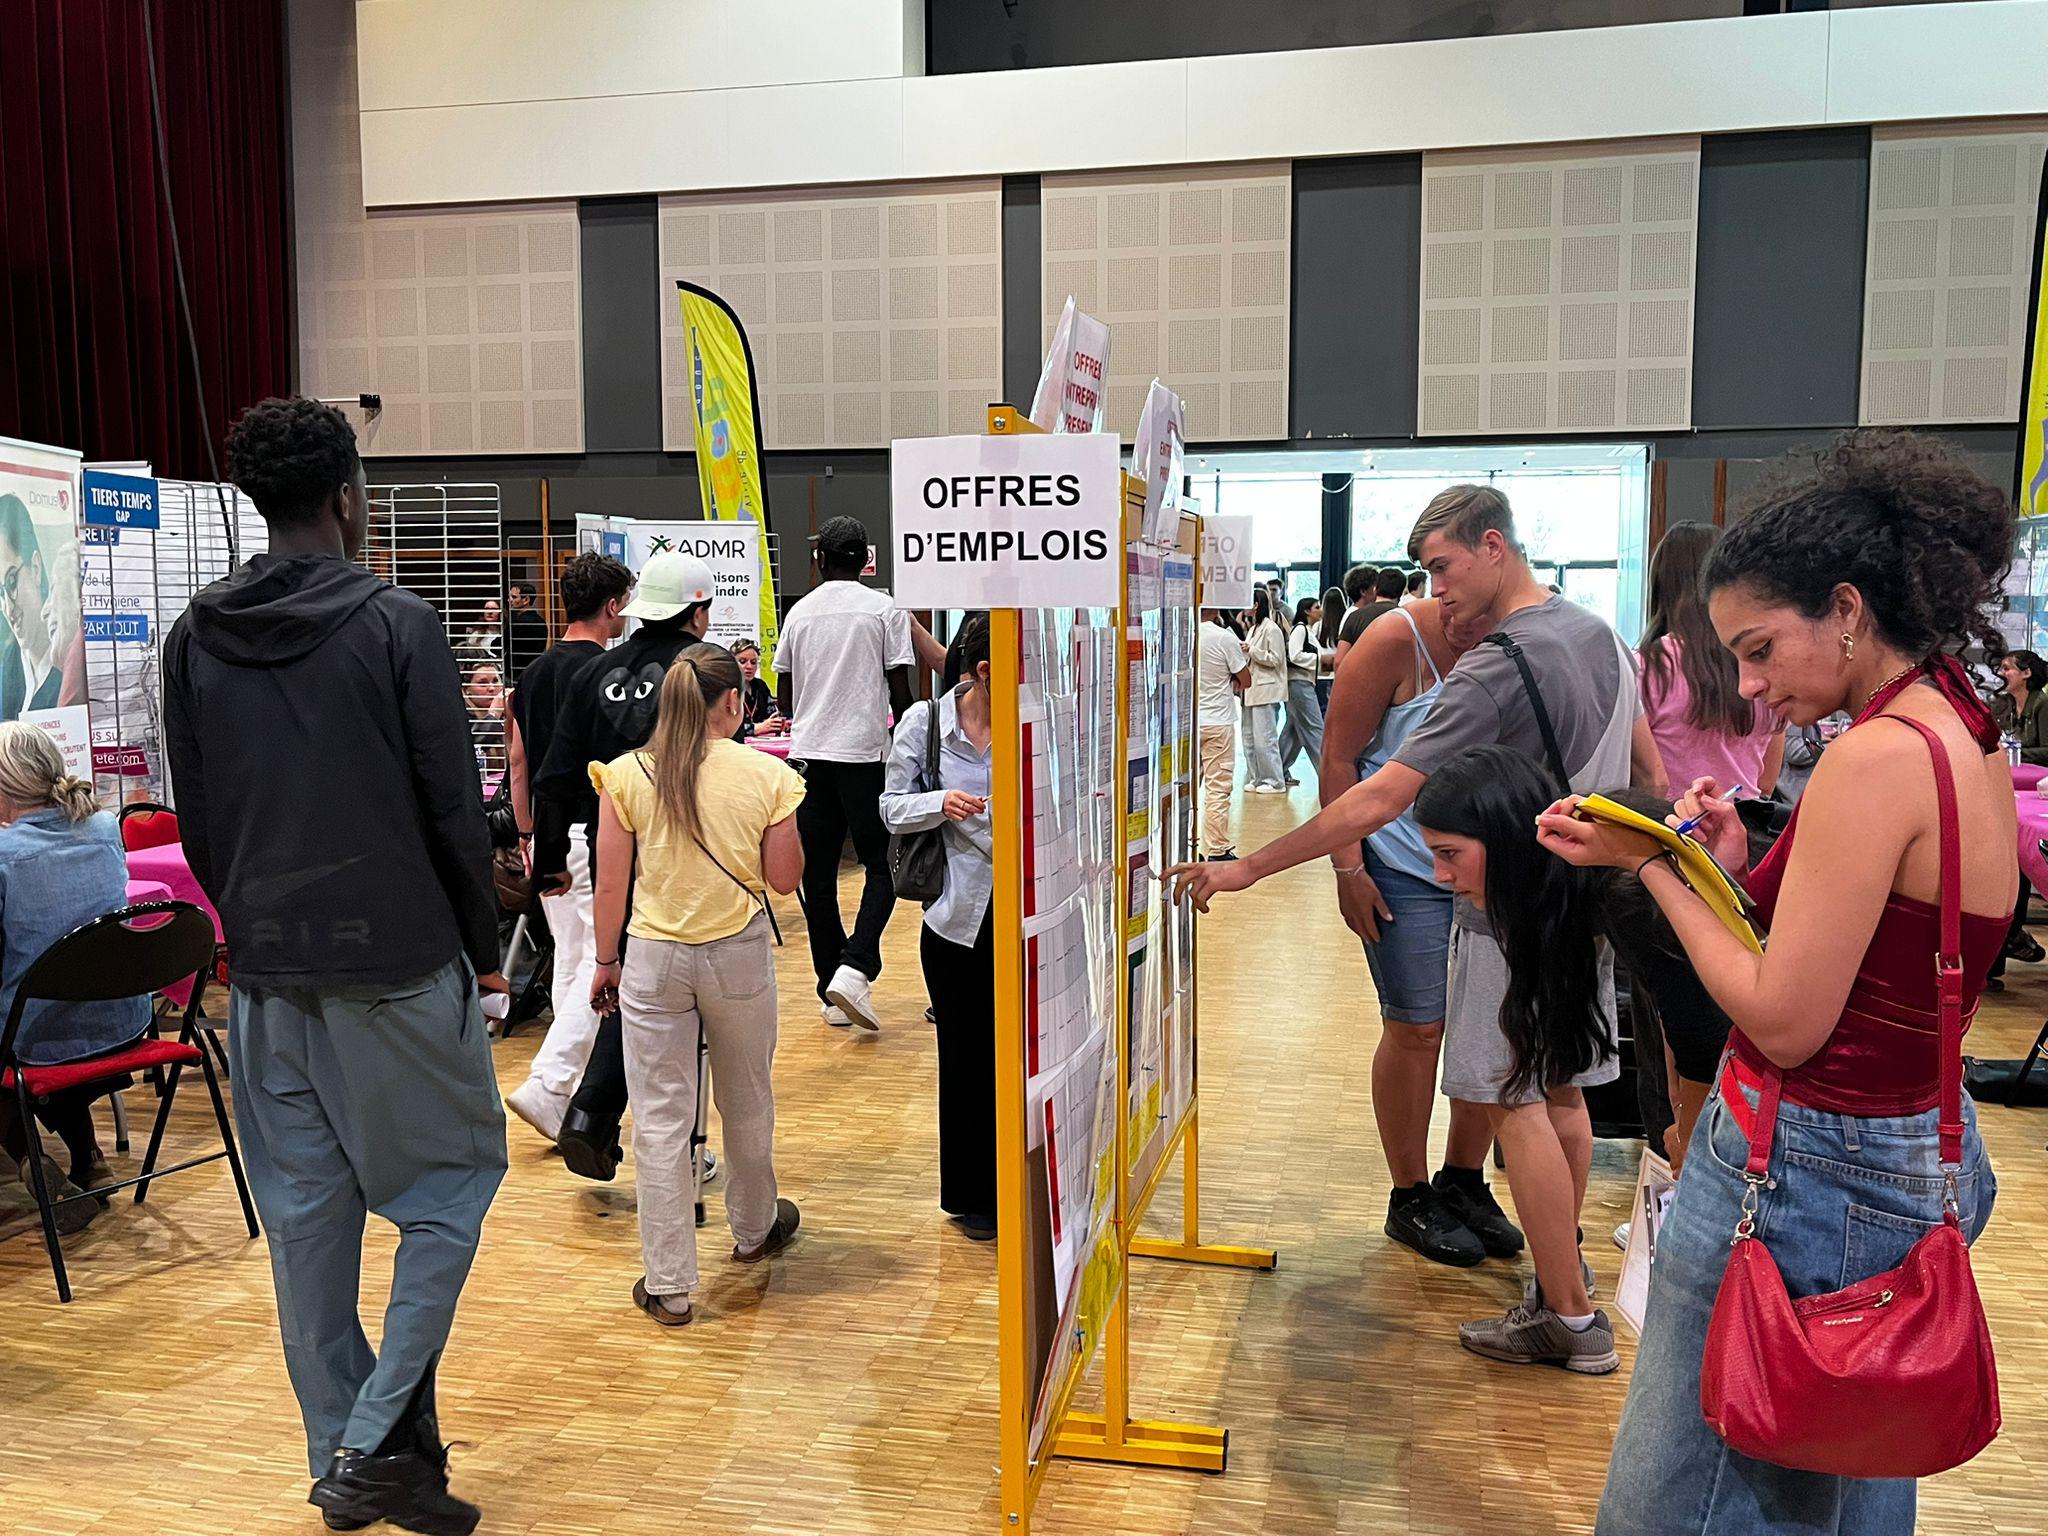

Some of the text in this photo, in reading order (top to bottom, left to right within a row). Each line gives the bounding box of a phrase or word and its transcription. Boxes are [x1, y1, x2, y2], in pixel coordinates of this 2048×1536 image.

[91, 488, 151, 511] TIERS TEMPS
[923, 474, 1080, 508] OFFRES
[115, 510, 130, 522] GAP
[679, 540, 745, 558] ADMR
